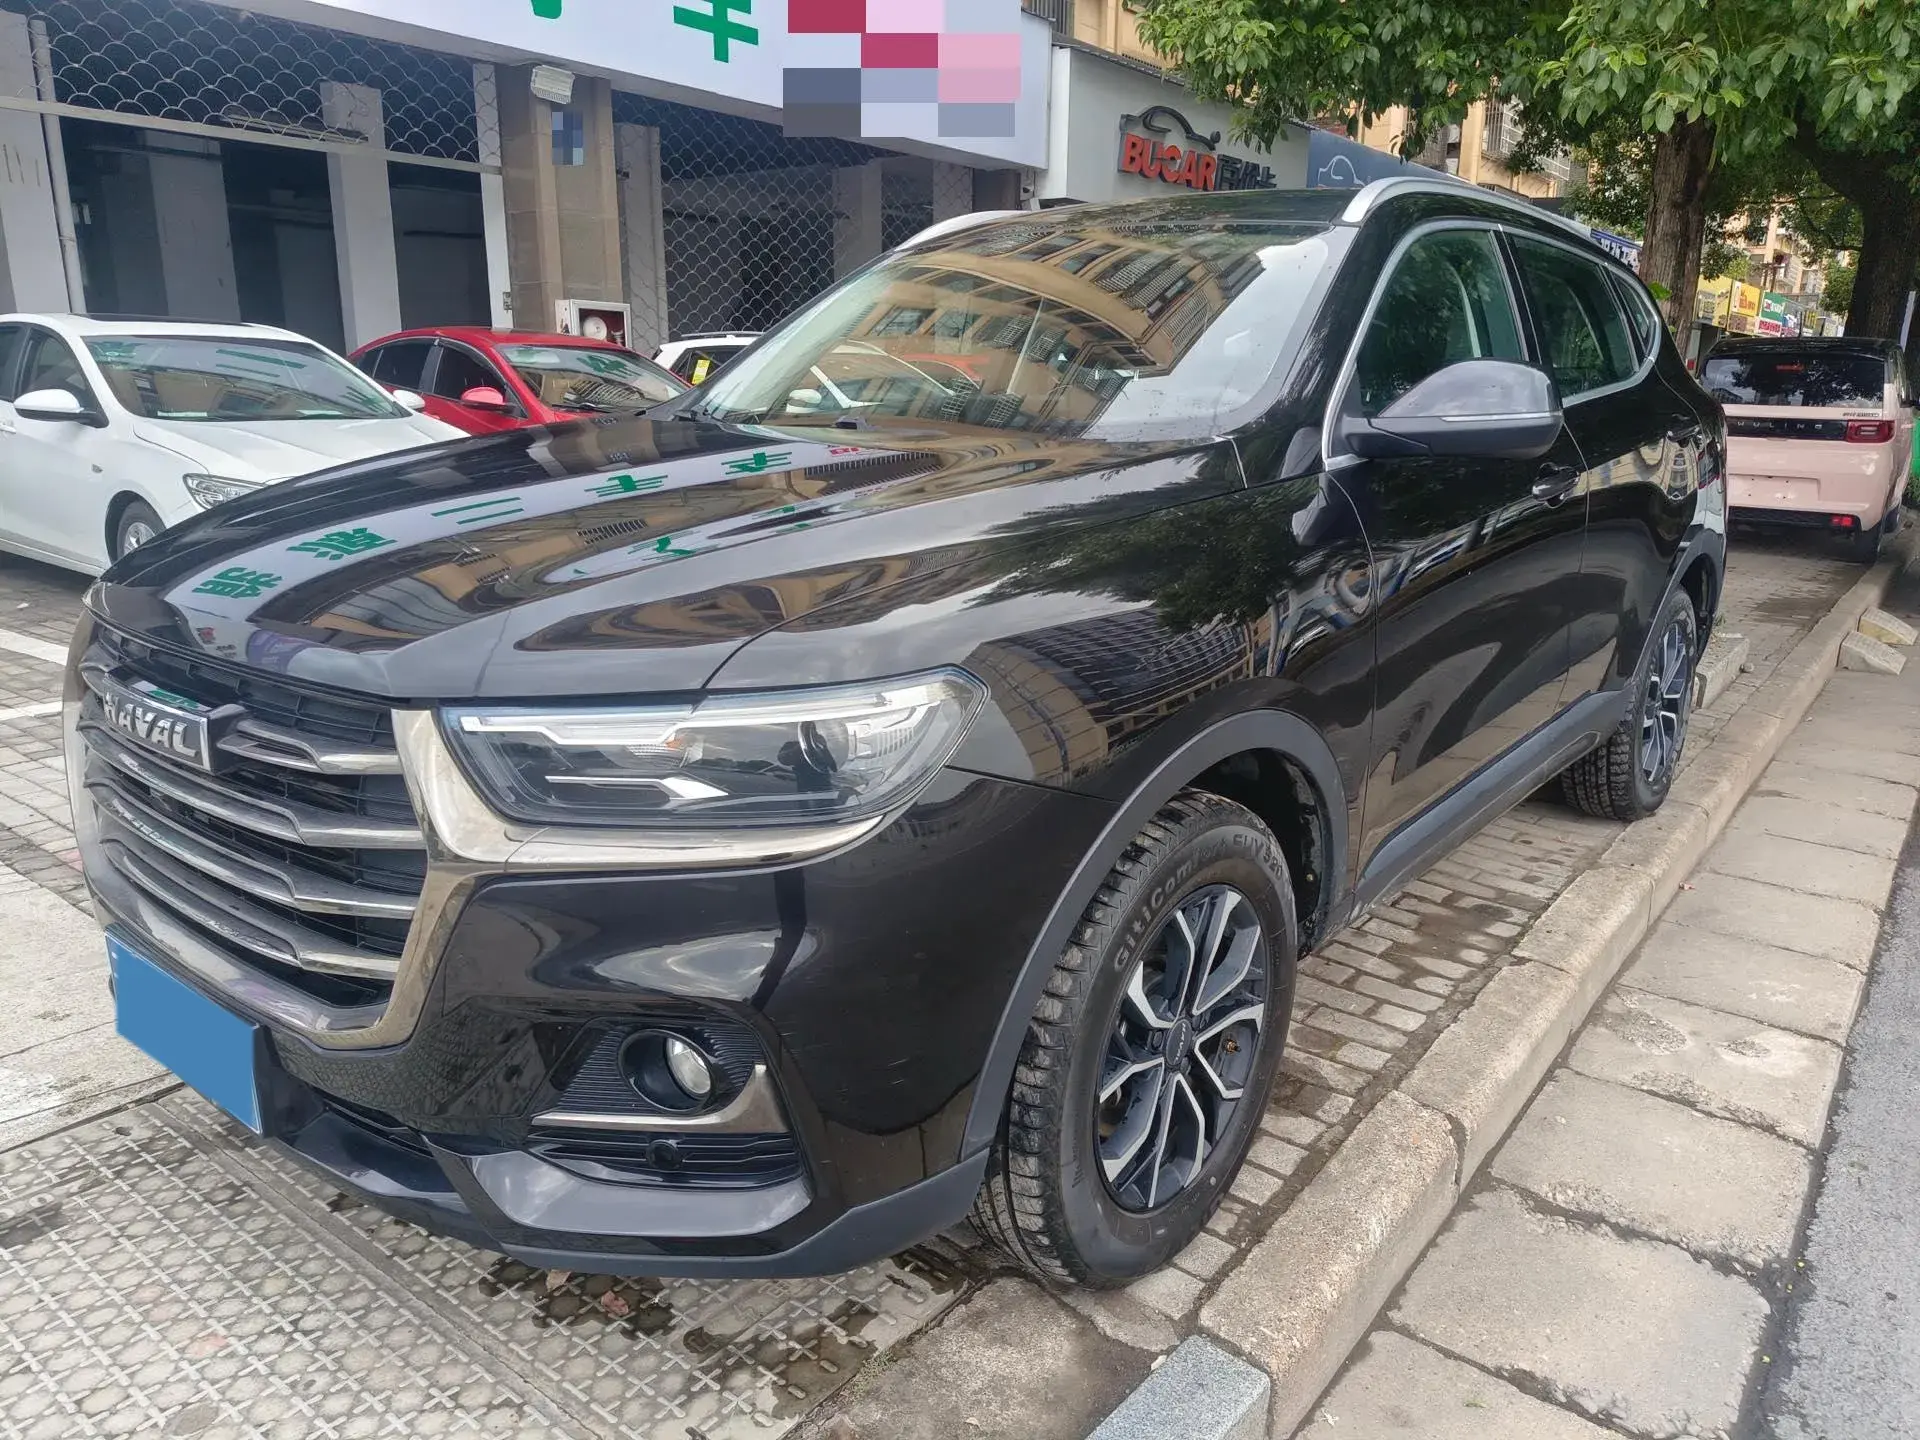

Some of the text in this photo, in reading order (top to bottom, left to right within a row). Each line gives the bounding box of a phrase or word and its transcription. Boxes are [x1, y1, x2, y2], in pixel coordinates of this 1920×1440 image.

[1120, 132, 1216, 191] BUCAR
[1737, 421, 1822, 430] WULING
[103, 691, 199, 757] HAVAL
